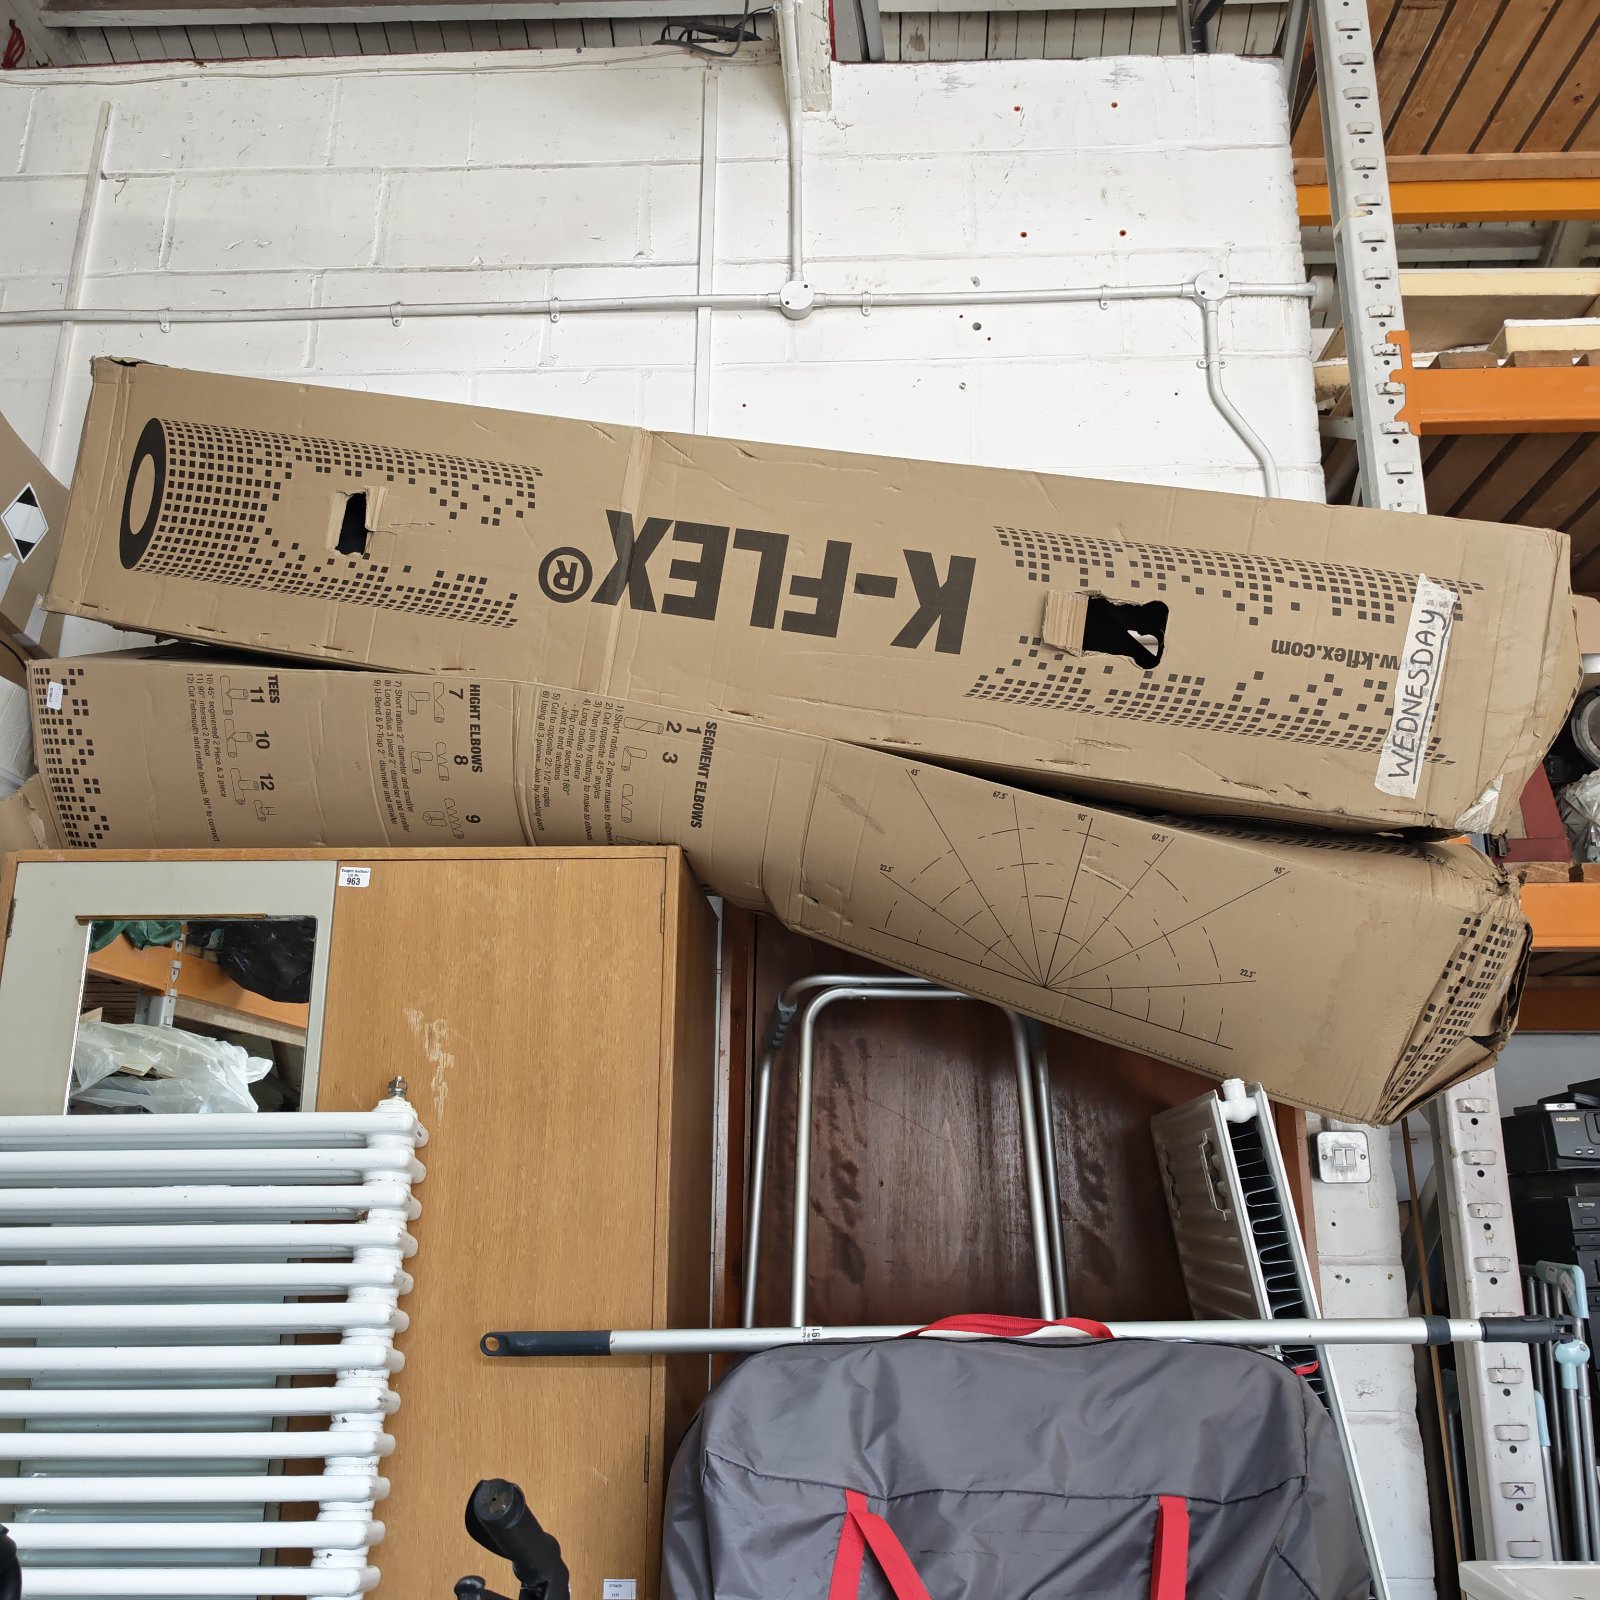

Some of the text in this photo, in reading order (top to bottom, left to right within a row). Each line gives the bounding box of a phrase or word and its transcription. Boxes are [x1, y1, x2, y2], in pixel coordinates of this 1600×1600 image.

[186, 673, 194, 683] 12)
[196, 673, 204, 684] 11)
[205, 673, 213, 684] 10)
[394, 680, 402, 688] 7)
[207, 686, 215, 699] 45°
[268, 675, 280, 704] TEES
[384, 689, 392, 706] Long
[551, 692, 561, 700] 5)
[1387, 609, 1447, 778] WEDNESDAY
[374, 688, 382, 715] U-Bend
[538, 700, 549, 720] Using
[550, 702, 560, 715] Cut
[582, 698, 591, 706] 4)
[593, 700, 602, 708] 3)
[189, 699, 199, 735] Fishmouth
[199, 701, 208, 730] intersect
[208, 701, 219, 739] segmented
[386, 708, 394, 730] radius
[396, 710, 404, 732] radius
[550, 716, 558, 724] to
[560, 707, 569, 725] Joint
[569, 709, 579, 722] Flip
[579, 708, 590, 726] Long
[603, 712, 612, 725] Cut
[612, 713, 624, 735] Short
[376, 724, 384, 748] P-Trap
[470, 684, 483, 773] HIGHT ELBOWS
[566, 724, 575, 748] center
[588, 729, 596, 742] join
[686, 726, 701, 734] 1
[193, 736, 201, 749] and
[203, 738, 211, 756] Piece
[250, 686, 275, 791] 11 10 12
[386, 738, 395, 757] piece
[545, 725, 556, 755] opposite
[557, 736, 565, 750] end
[576, 728, 587, 751] radius
[586, 744, 594, 752] by
[597, 727, 608, 758] opposite
[609, 736, 619, 759] radius
[662, 720, 682, 764] 2 3
[195, 750, 204, 770] rotate
[214, 747, 222, 765] Piece
[398, 745, 407, 775] diameter
[449, 688, 481, 823] 7 8 9
[563, 750, 572, 776] section
[379, 760, 389, 789] diameter
[554, 751, 563, 780] sections
[573, 759, 582, 779] piece
[596, 760, 604, 774] 45°
[690, 721, 717, 828] SEGMENT ELBOWS
[198, 772, 208, 795] branch
[390, 770, 400, 798] diameter
[401, 776, 411, 789] and
[593, 775, 602, 799] angles
[605, 768, 614, 787] piece
[217, 780, 227, 797] piece
[384, 790, 393, 802] and
[533, 784, 541, 792] by
[542, 786, 551, 807] angles
[993, 791, 1008, 800] 67.5°
[395, 800, 404, 811] and
[583, 793, 591, 812] make
[604, 790, 612, 812] makes
[1078, 813, 1088, 821] 90°
[207, 818, 220, 842] connect
[1152, 833, 1168, 843] 67.5°
[1274, 866, 1285, 875] 45°
[346, 877, 361, 886] 963
[1240, 969, 1256, 978] 22.5°
